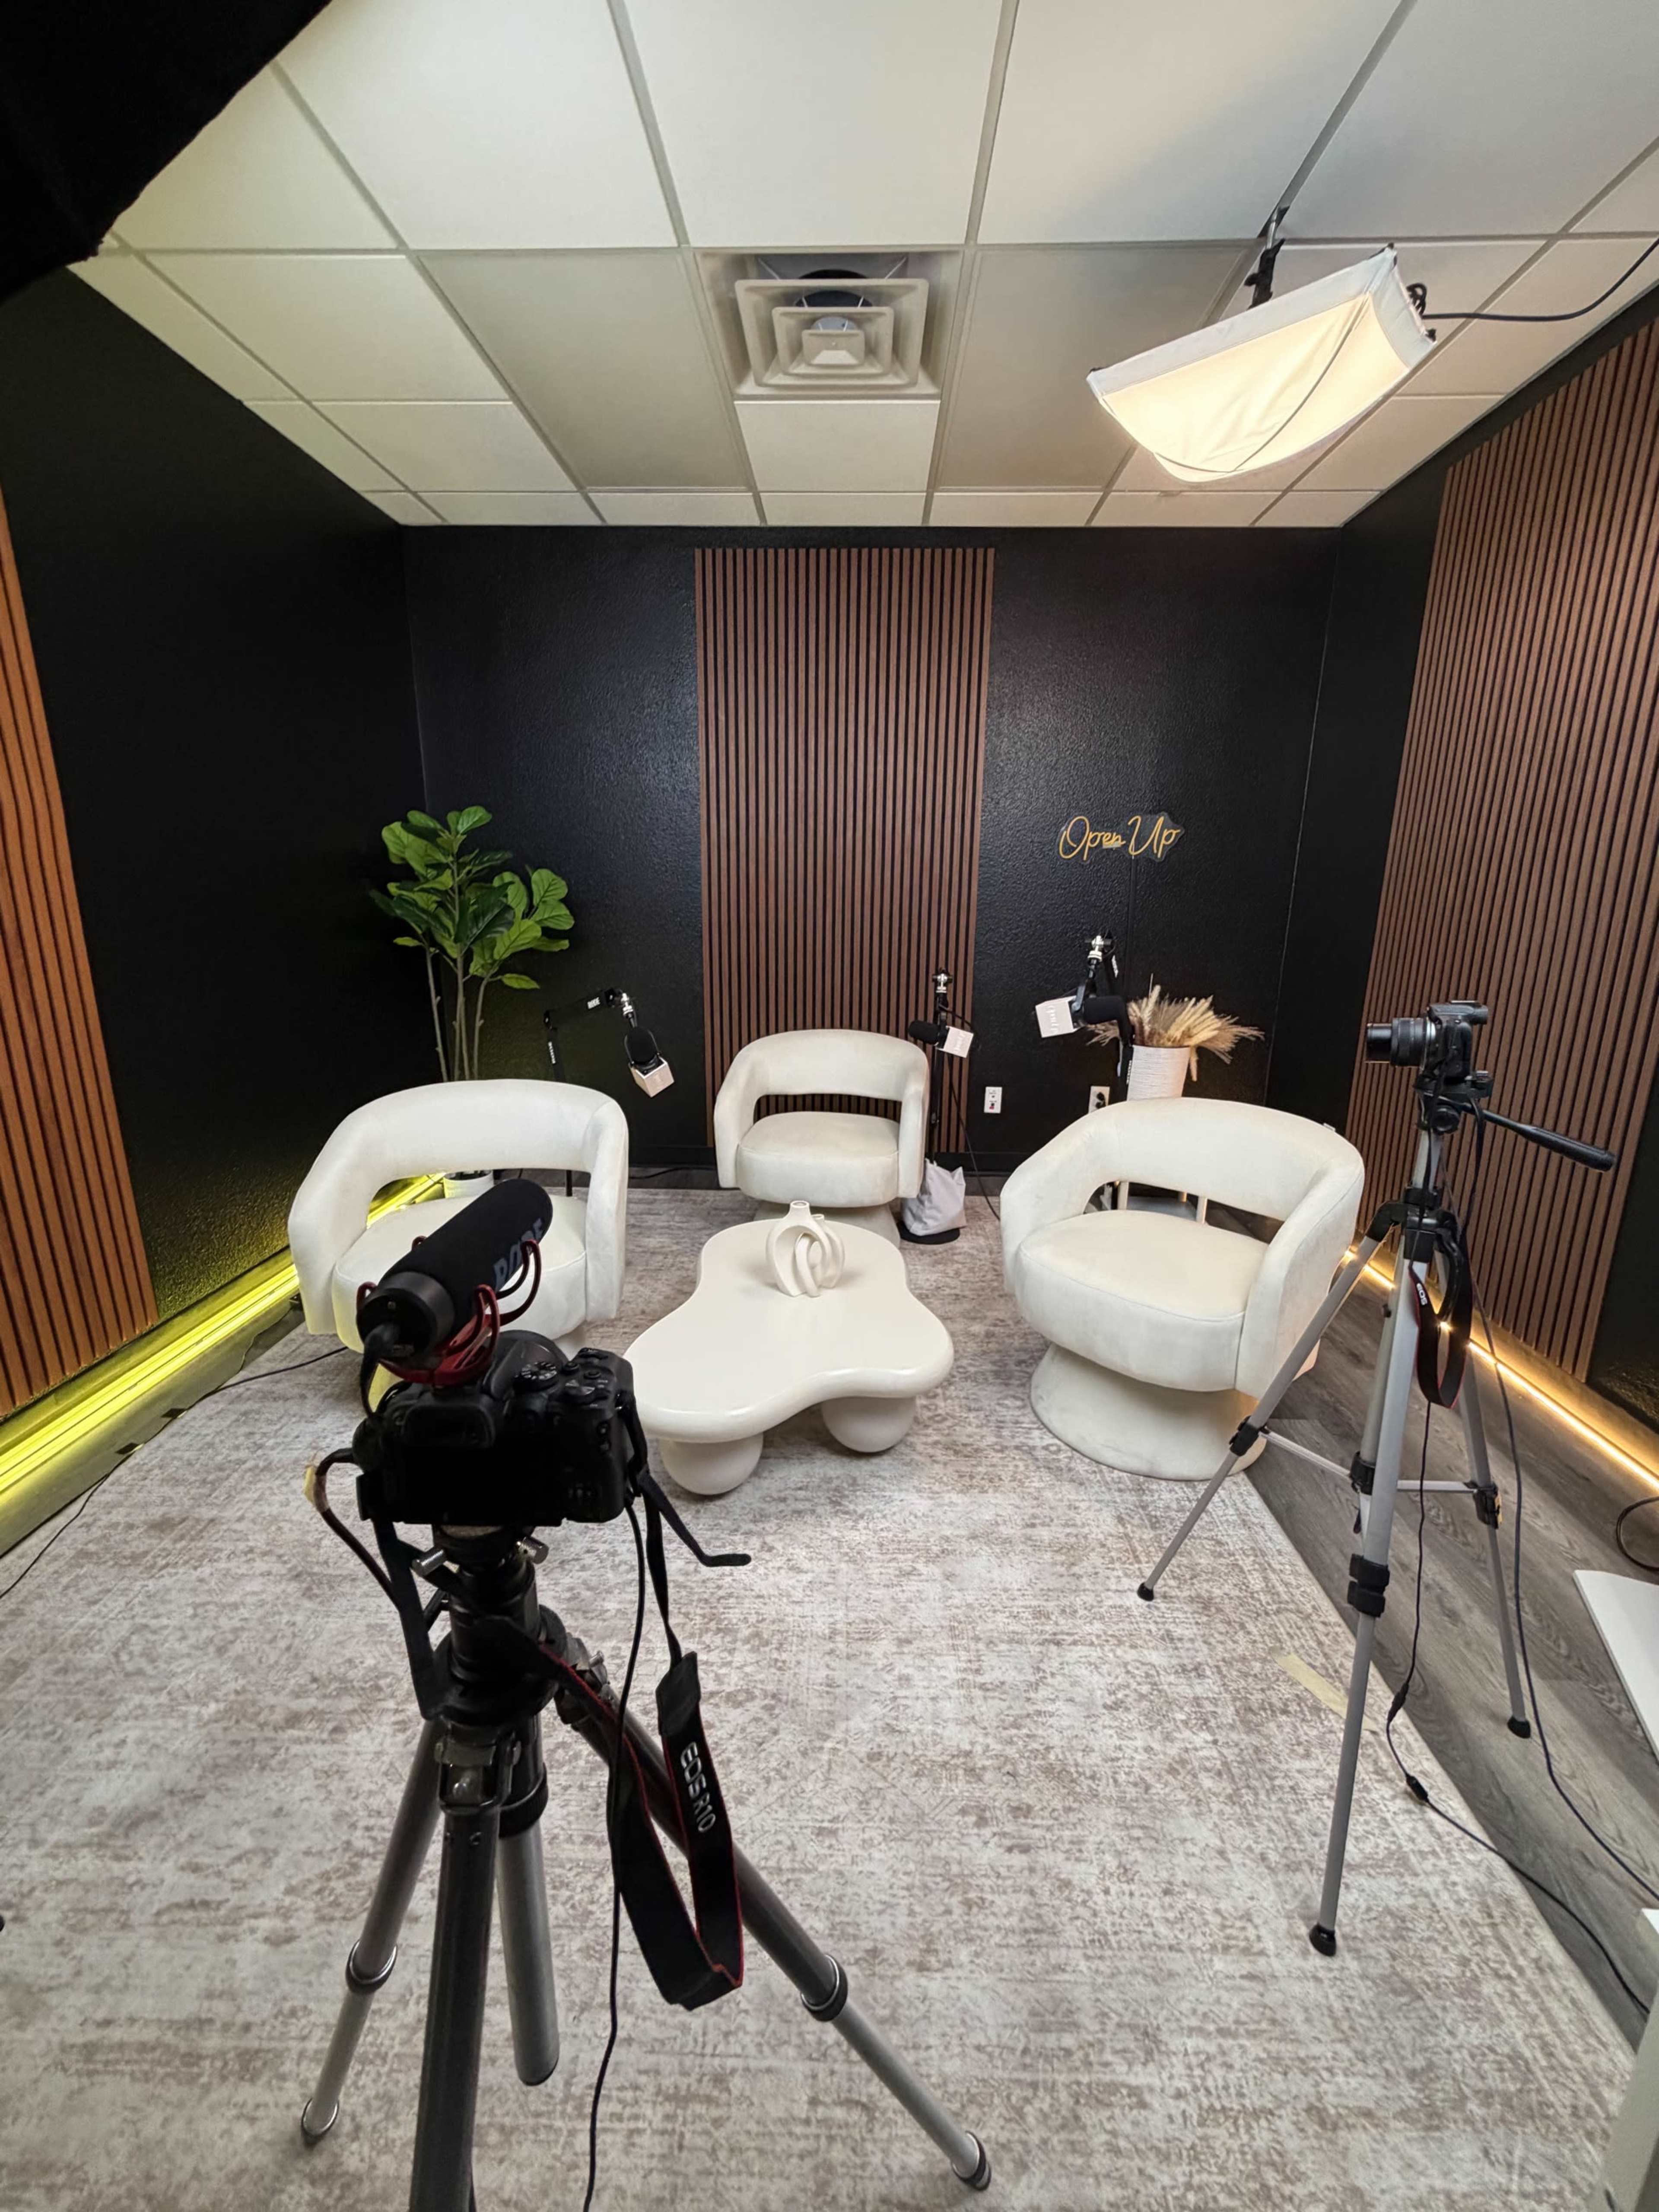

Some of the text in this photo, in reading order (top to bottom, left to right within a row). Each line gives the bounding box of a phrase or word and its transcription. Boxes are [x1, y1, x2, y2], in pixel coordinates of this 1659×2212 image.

[1059, 815, 1181, 861] Open Up
[1416, 1283, 1428, 1306] EOS
[680, 1742, 716, 1833] EOS R10
